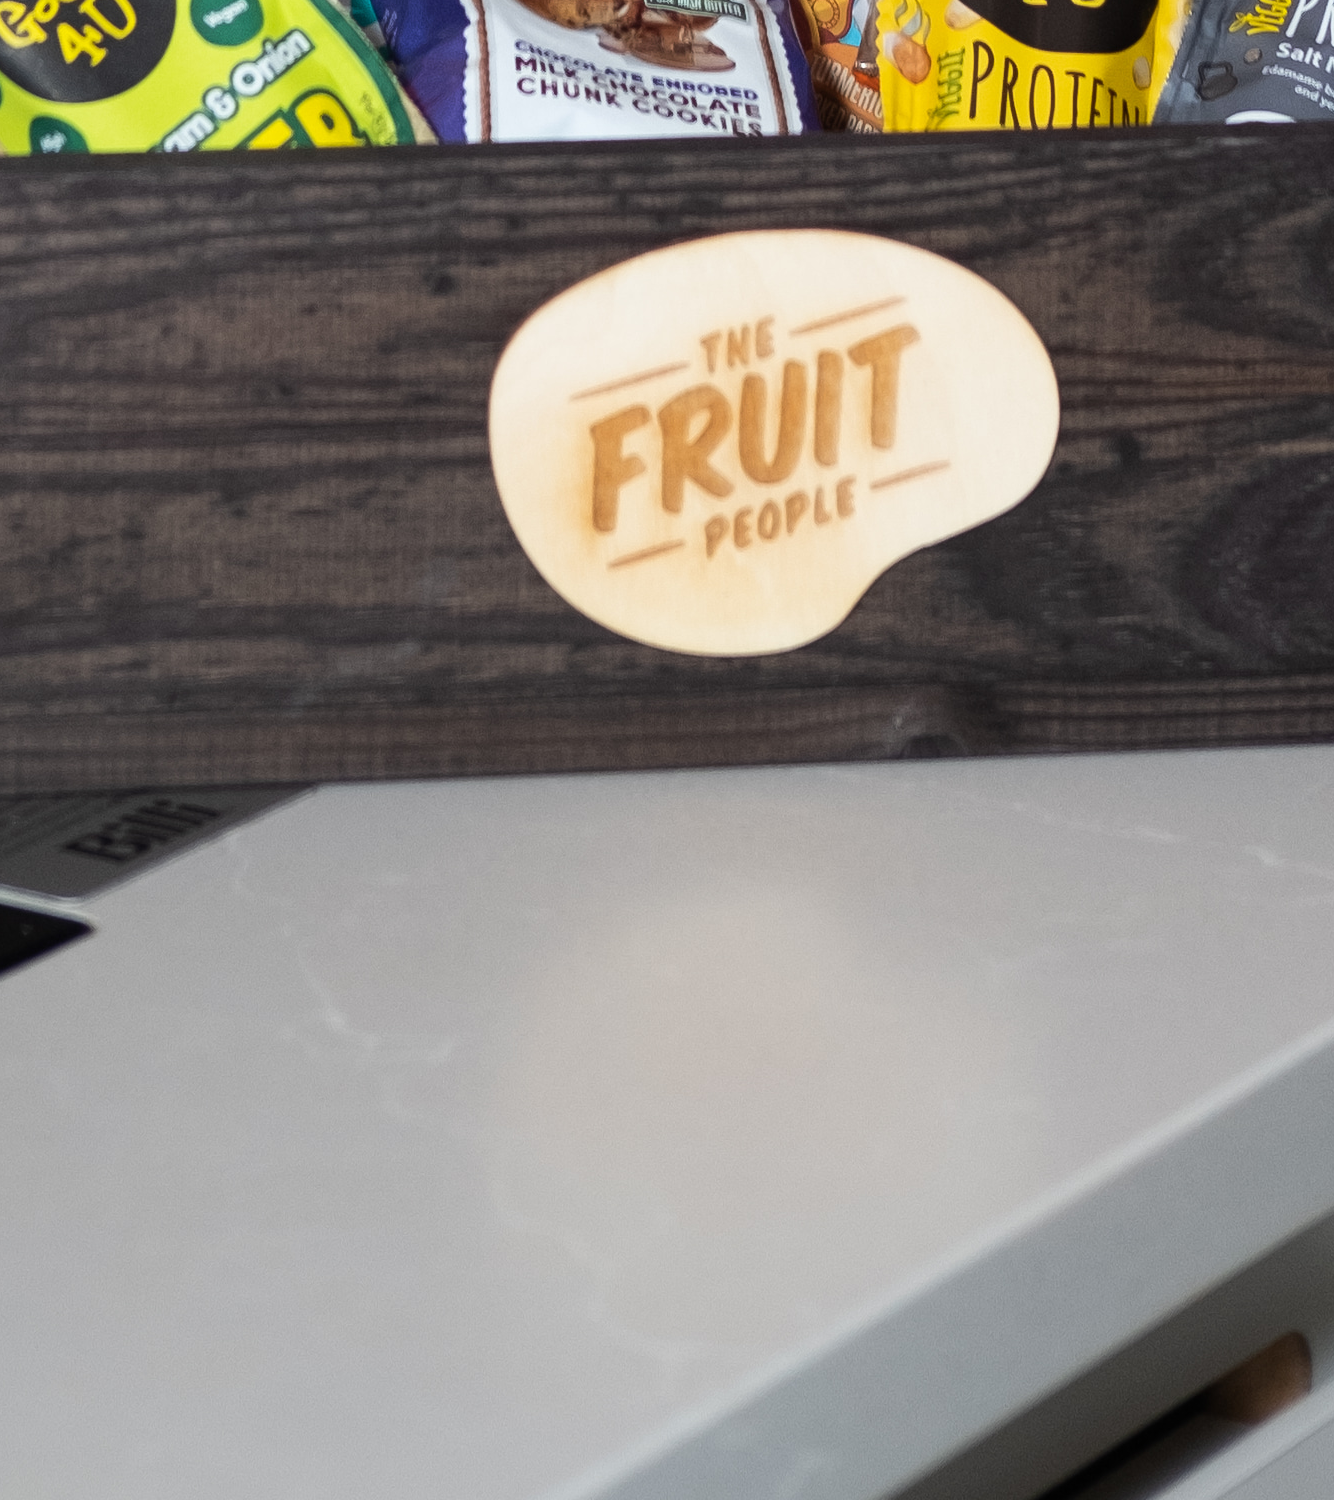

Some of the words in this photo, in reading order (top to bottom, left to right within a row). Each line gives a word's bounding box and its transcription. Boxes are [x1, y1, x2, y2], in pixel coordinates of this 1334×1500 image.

[232, 30, 311, 97] Onion
[967, 39, 1148, 130] PROTEIN
[1275, 41, 1324, 69] Salt
[514, 56, 577, 78] MILK
[591, 73, 762, 120] CHOCOLATE
[516, 76, 624, 108] CHUNK
[700, 316, 776, 373] THE
[589, 324, 921, 534] FRUIT
[703, 475, 858, 560] PEOPLE
